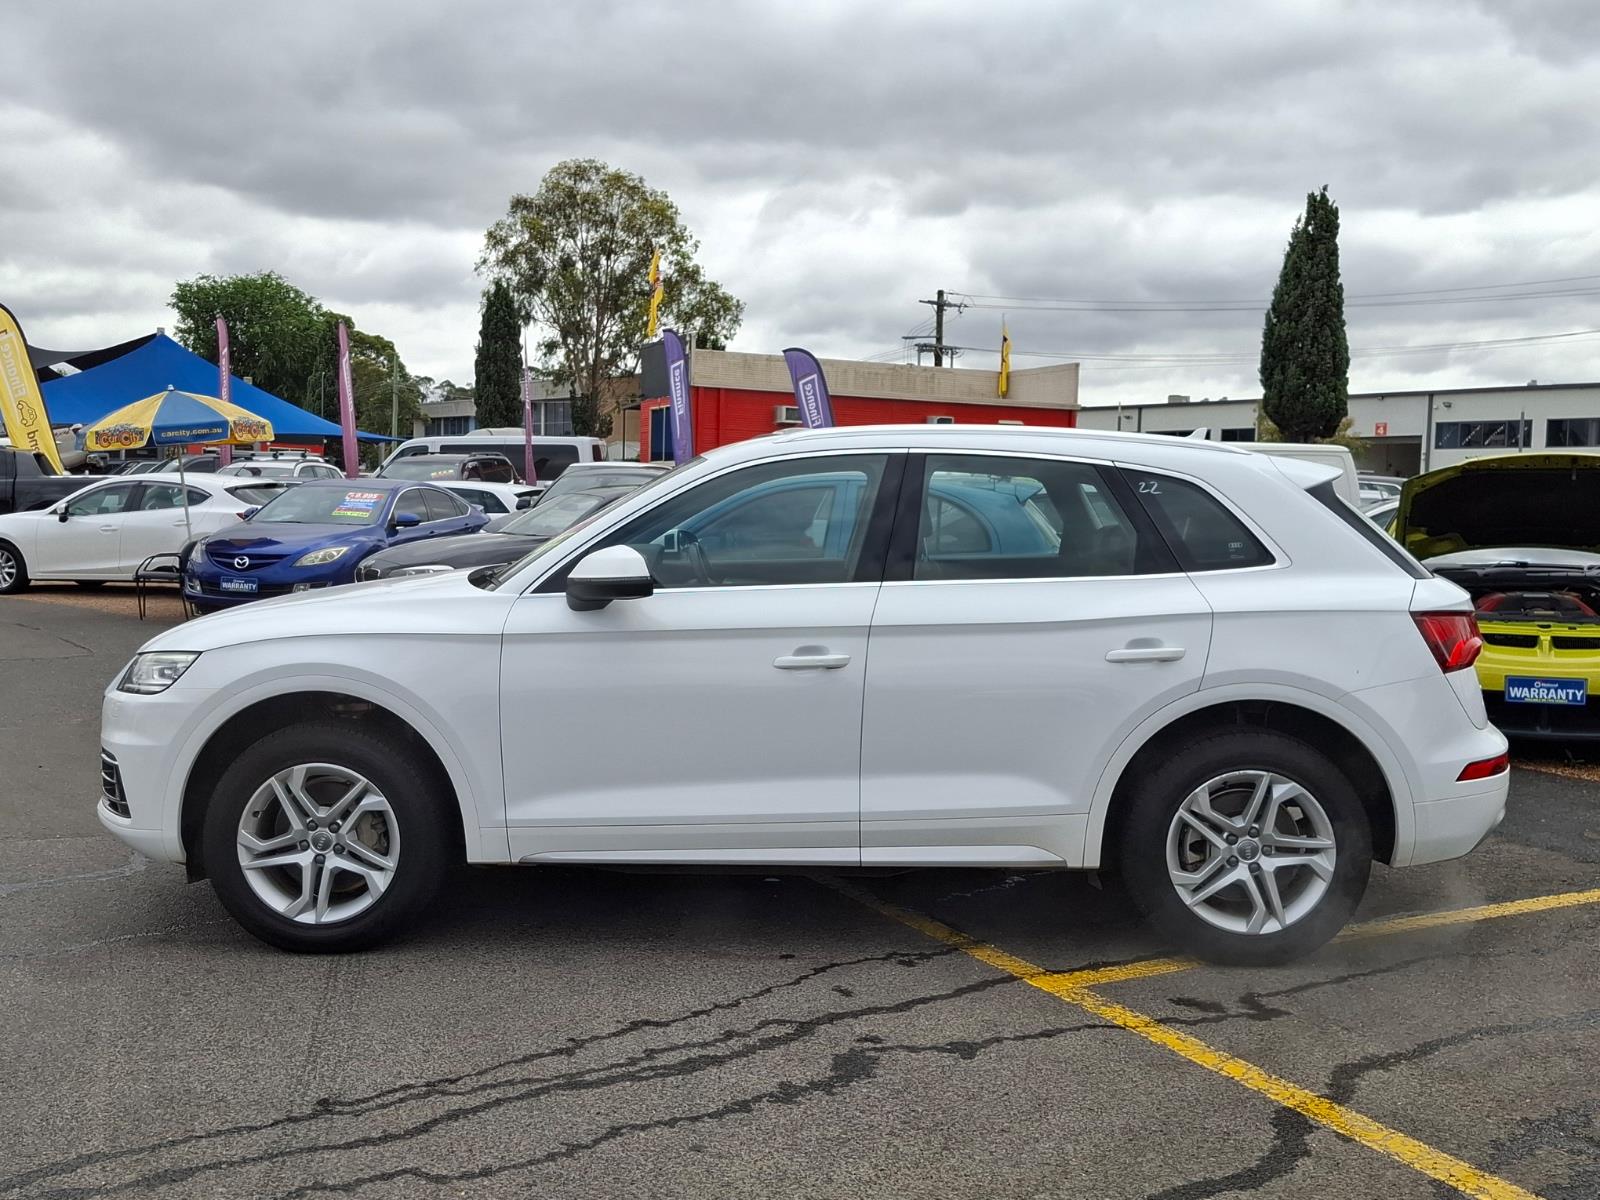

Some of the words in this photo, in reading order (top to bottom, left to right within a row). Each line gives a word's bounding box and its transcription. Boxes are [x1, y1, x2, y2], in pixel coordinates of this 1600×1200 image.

[161, 428, 223, 438] carcity.com.au
[1138, 481, 1162, 494] 22
[222, 582, 257, 591] WARRANTY
[1509, 686, 1584, 701] WARRANTY
